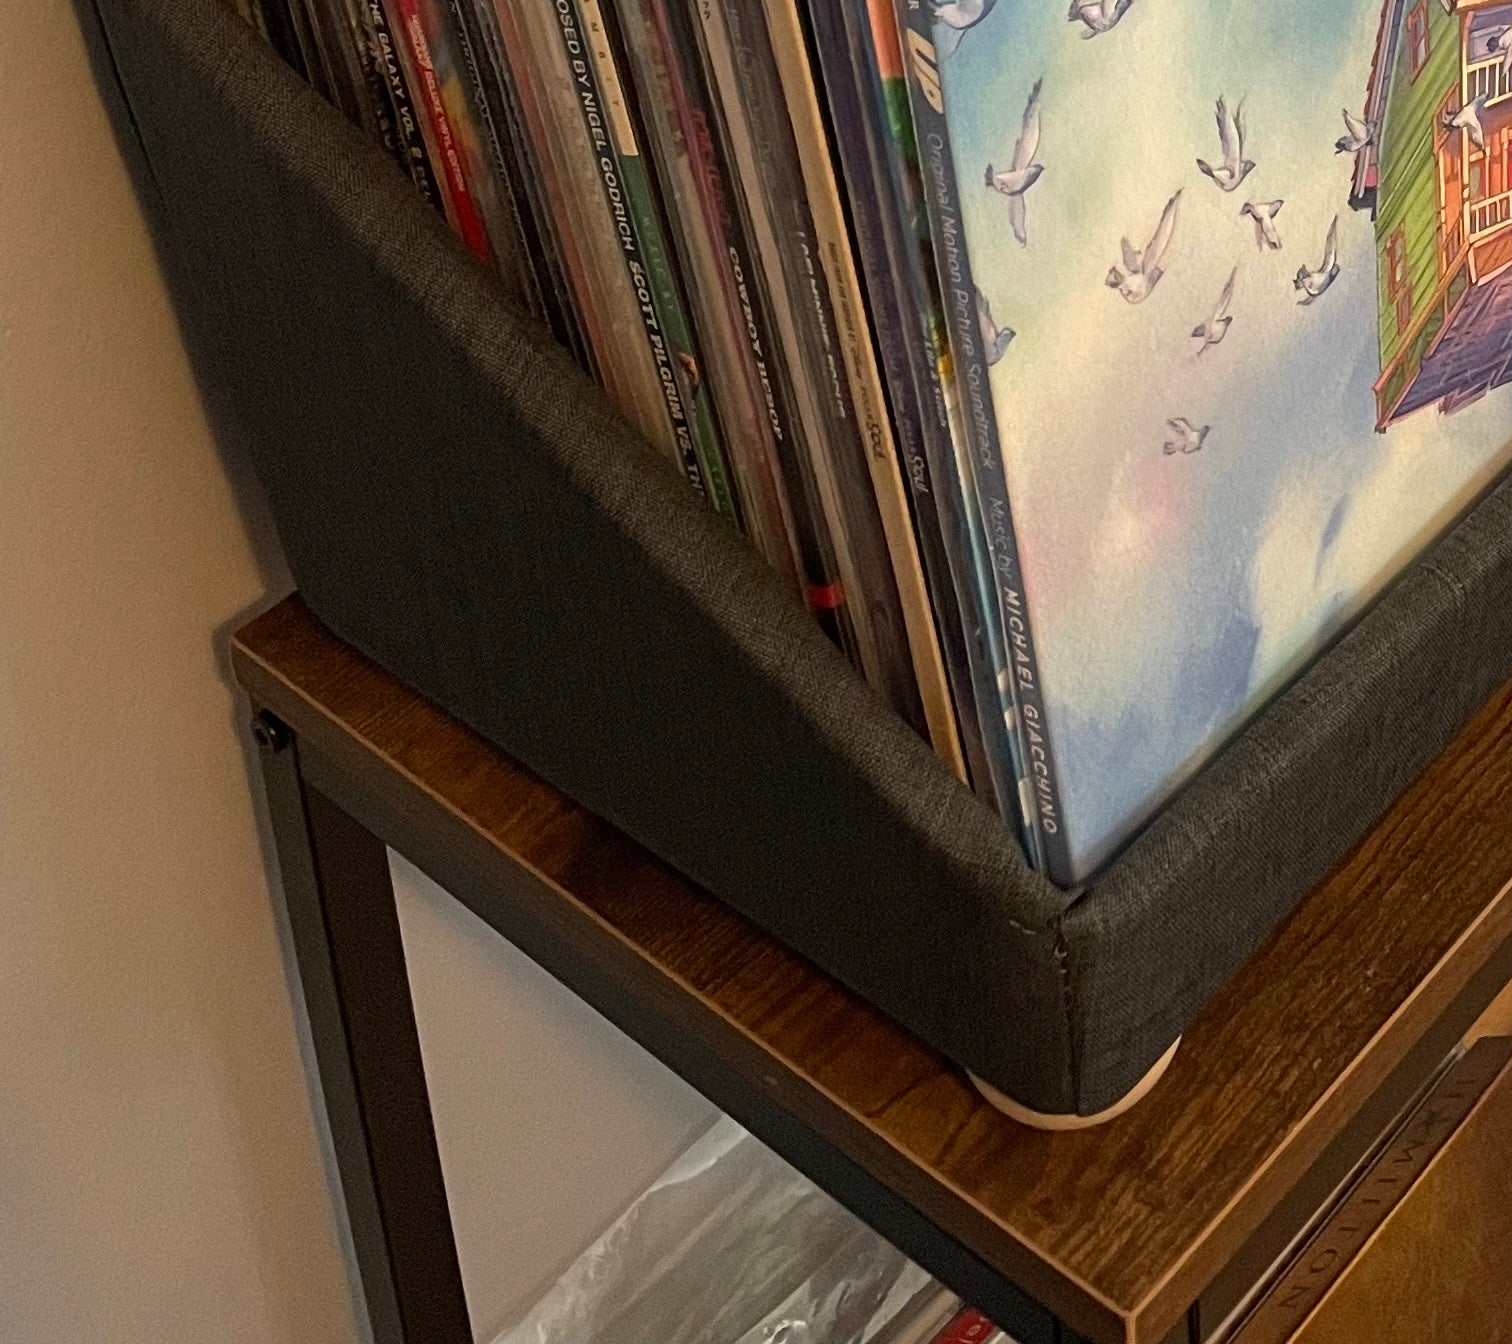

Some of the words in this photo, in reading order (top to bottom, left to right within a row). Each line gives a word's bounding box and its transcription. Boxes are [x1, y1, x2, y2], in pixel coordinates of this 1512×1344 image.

[376, 31, 405, 100] GALAXY
[905, 24, 946, 117] UP
[570, 57, 589, 85] BY
[580, 90, 608, 152] NIGEL
[598, 154, 635, 251] GODRICH
[923, 131, 956, 212] Original
[938, 214, 967, 282] Motion
[627, 258, 659, 330] SCOTT
[648, 333, 682, 420] PILGRIM
[726, 245, 764, 356] COWBOY
[951, 286, 980, 356] Picture
[962, 362, 1001, 468] Soundtrack
[985, 493, 1011, 547] Music
[995, 550, 1015, 579] by
[1000, 584, 1036, 690] MICHAEL
[1019, 701, 1061, 834] GIACCHINO
